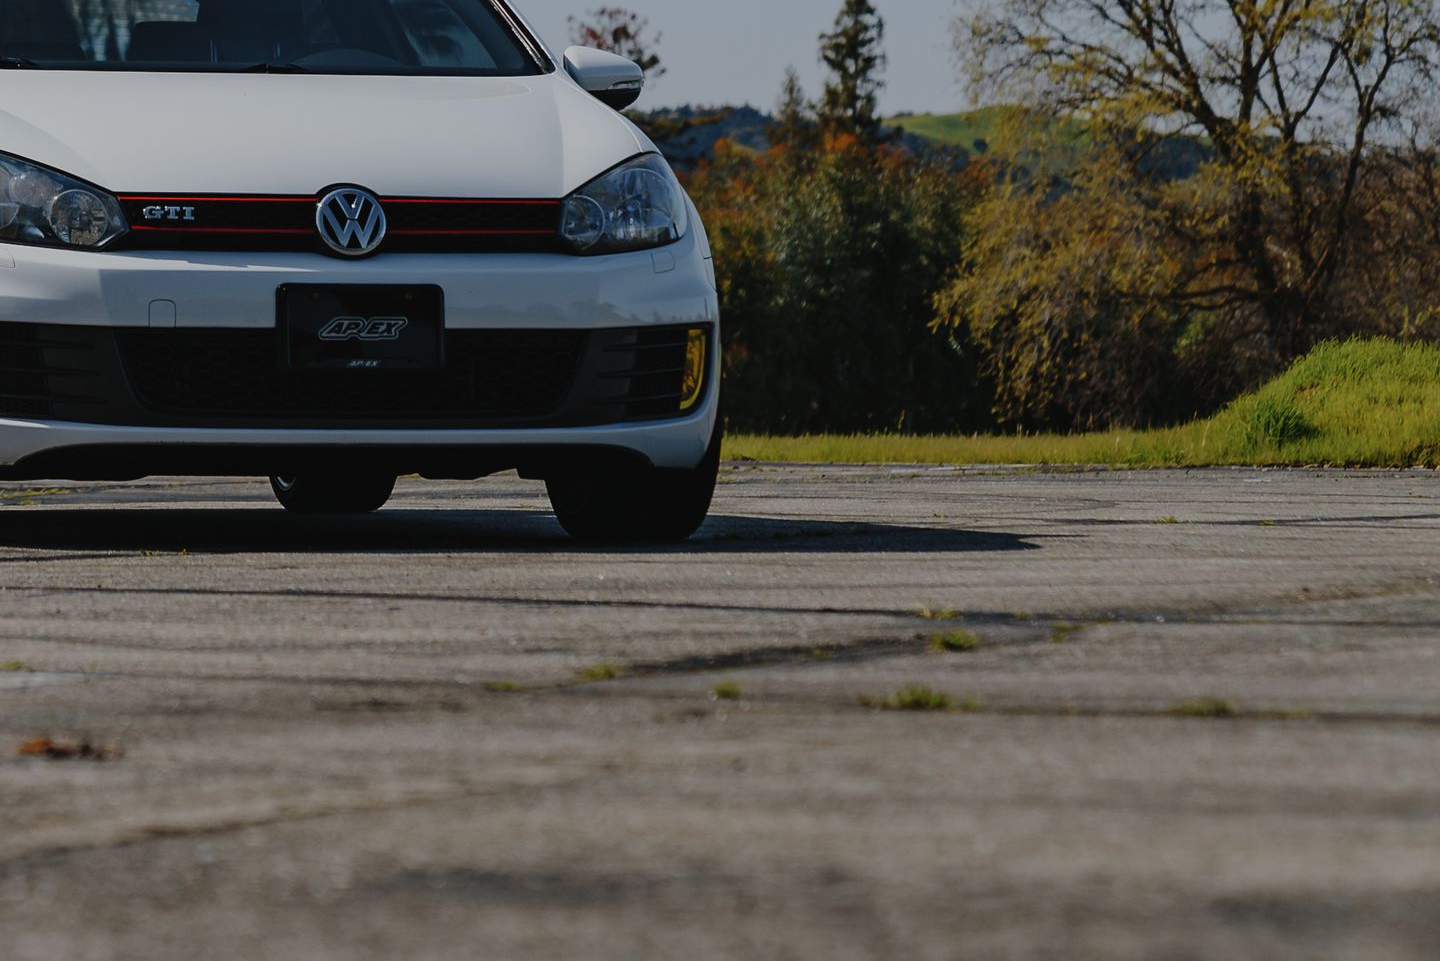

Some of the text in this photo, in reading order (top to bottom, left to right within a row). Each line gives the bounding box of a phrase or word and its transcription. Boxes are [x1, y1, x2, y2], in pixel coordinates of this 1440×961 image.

[143, 205, 195, 221] GTI
[320, 189, 382, 251] VW
[320, 317, 406, 340] APEX
